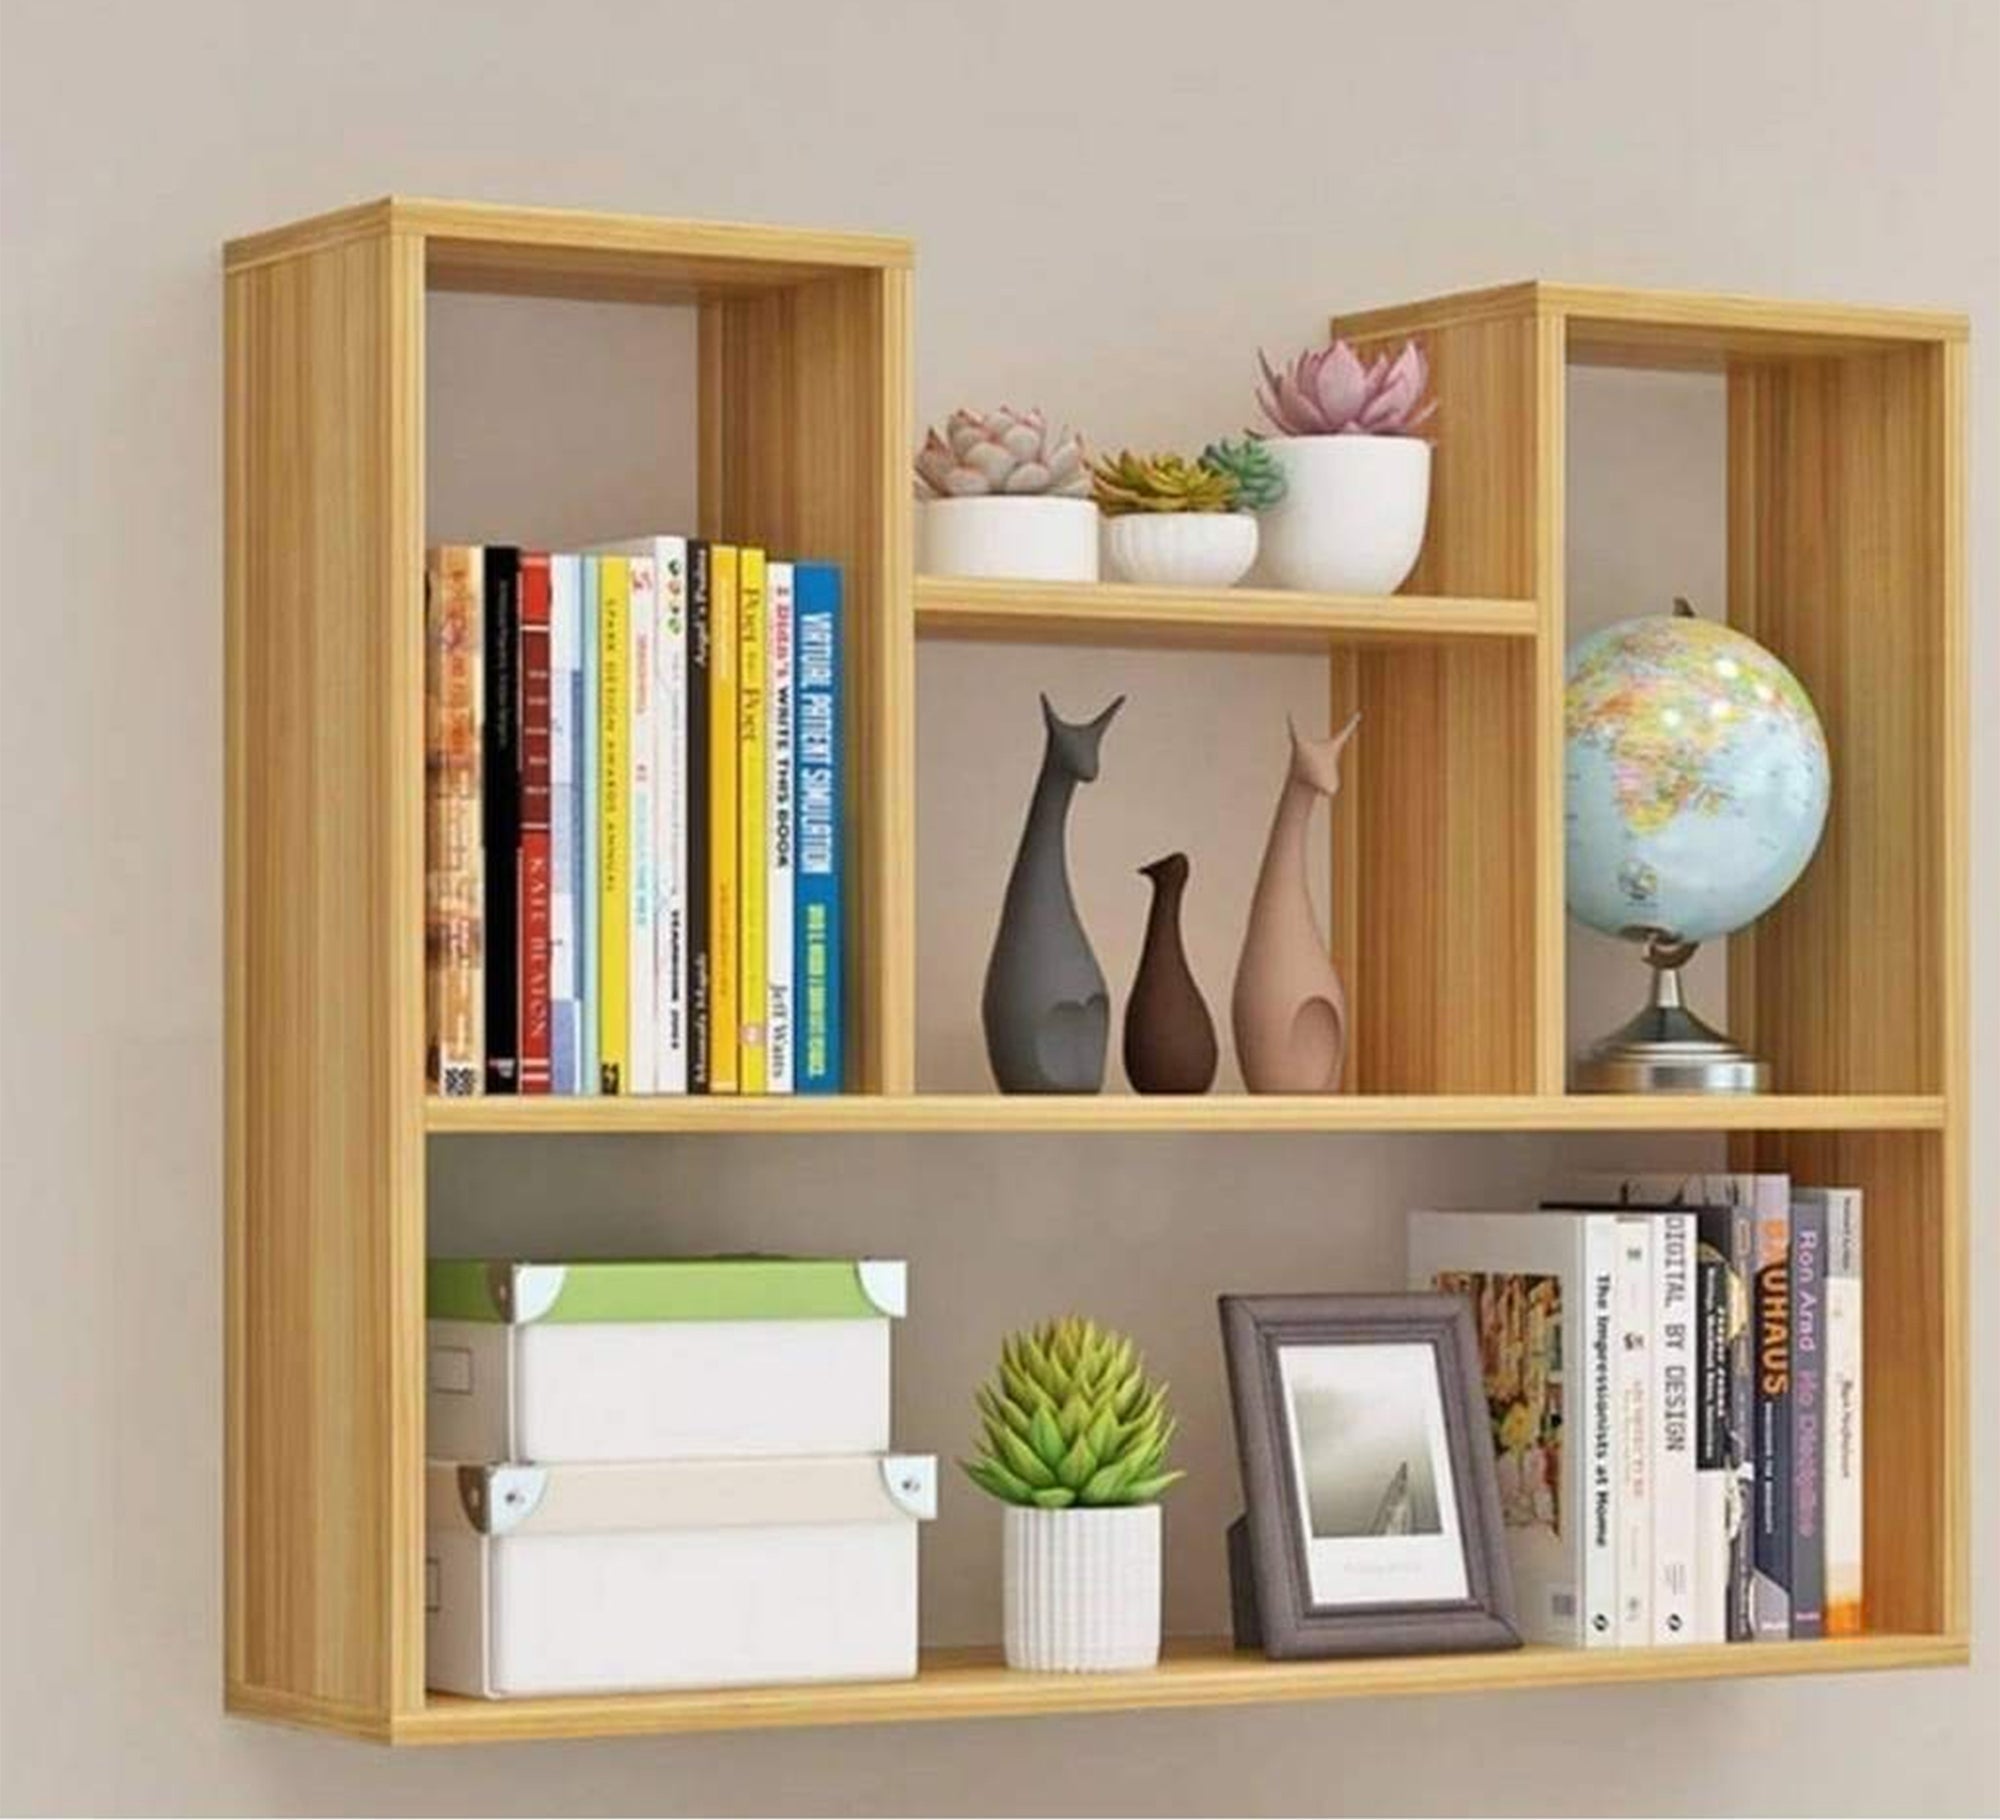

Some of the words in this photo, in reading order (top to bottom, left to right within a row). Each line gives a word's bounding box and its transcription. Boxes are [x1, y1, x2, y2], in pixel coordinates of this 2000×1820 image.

[800, 612, 833, 689] VIRTUAL
[606, 661, 617, 732] DESIGN
[777, 685, 790, 752] WRITE
[606, 740, 617, 813] AWARDS
[777, 758, 790, 806] THIS
[777, 809, 790, 869] BOOK
[800, 768, 833, 875] SIMULATION
[606, 822, 617, 889] ANNUAL
[529, 857, 547, 921] KATE
[529, 937, 547, 1038] BEATON
[769, 984, 790, 1019] Jeff
[772, 1023, 789, 1079] Watts
[1663, 1216, 1687, 1309] DIGITAL
[1799, 1230, 1818, 1284] Ron
[1596, 1274, 1612, 1309] The
[1762, 1219, 1791, 1396] BAUHAUS
[1799, 1290, 1818, 1352] Arad
[1664, 1323, 1687, 1352] BY
[1593, 1315, 1611, 1459] Impressionists
[1664, 1364, 1687, 1453] DESIGN
[1595, 1466, 1609, 1486] at
[1595, 1490, 1609, 1548] Home
